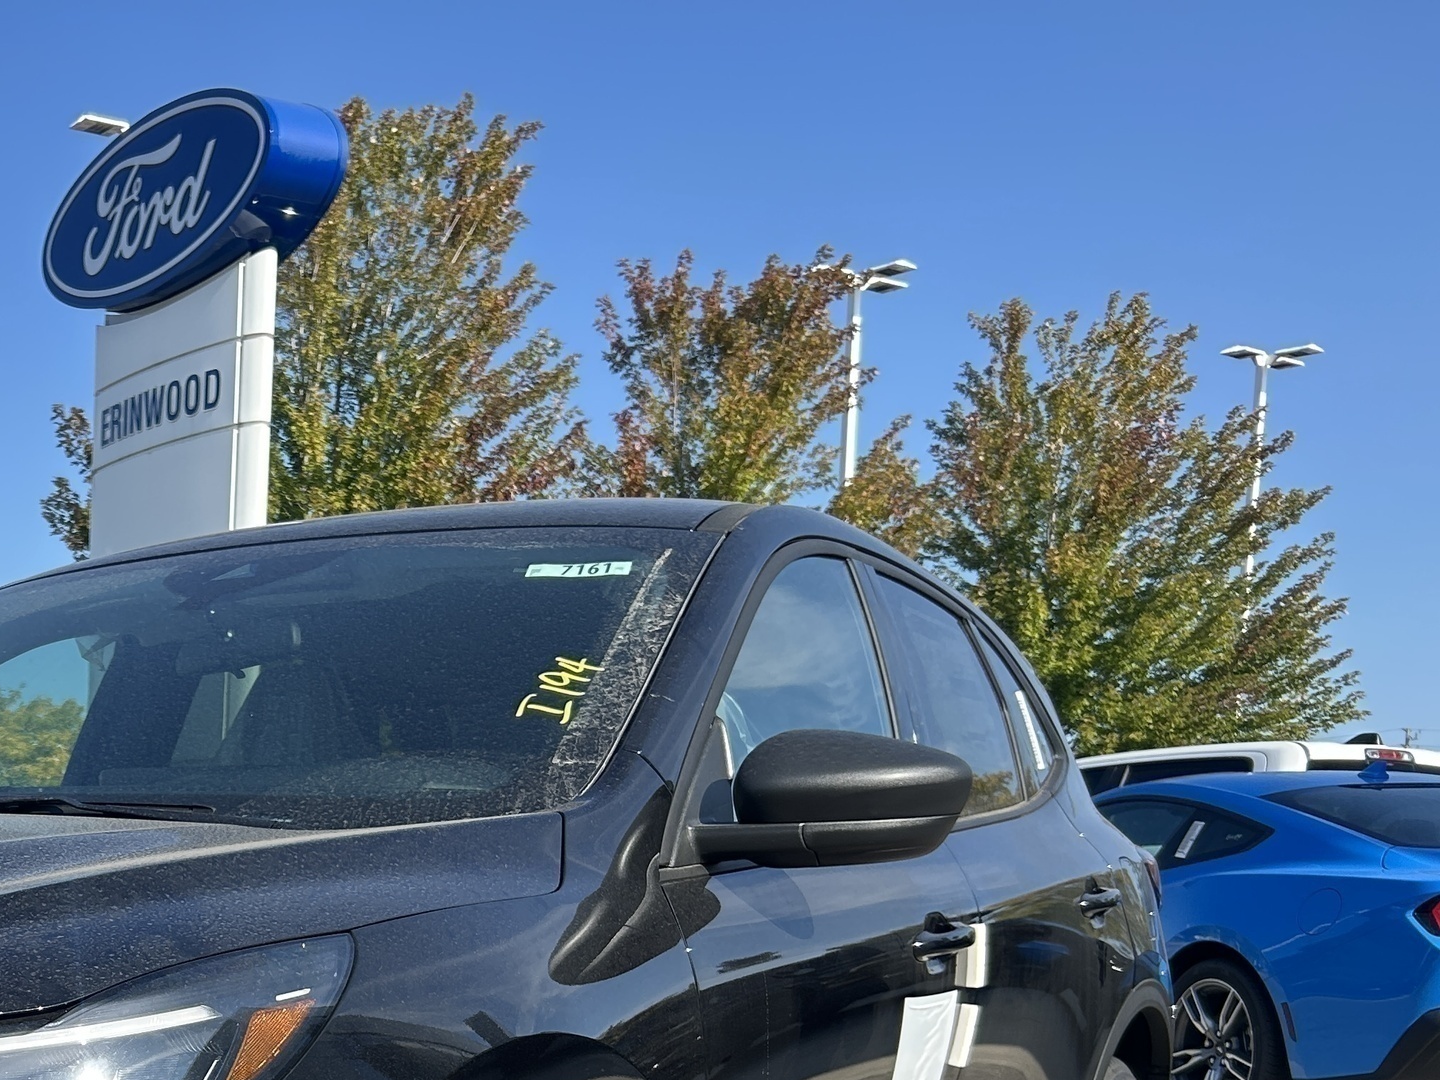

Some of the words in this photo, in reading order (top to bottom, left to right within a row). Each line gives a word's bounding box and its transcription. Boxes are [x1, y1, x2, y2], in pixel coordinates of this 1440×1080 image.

[83, 132, 217, 277] Ford
[100, 368, 221, 447] ERINWOOD
[561, 563, 612, 575] 7161
